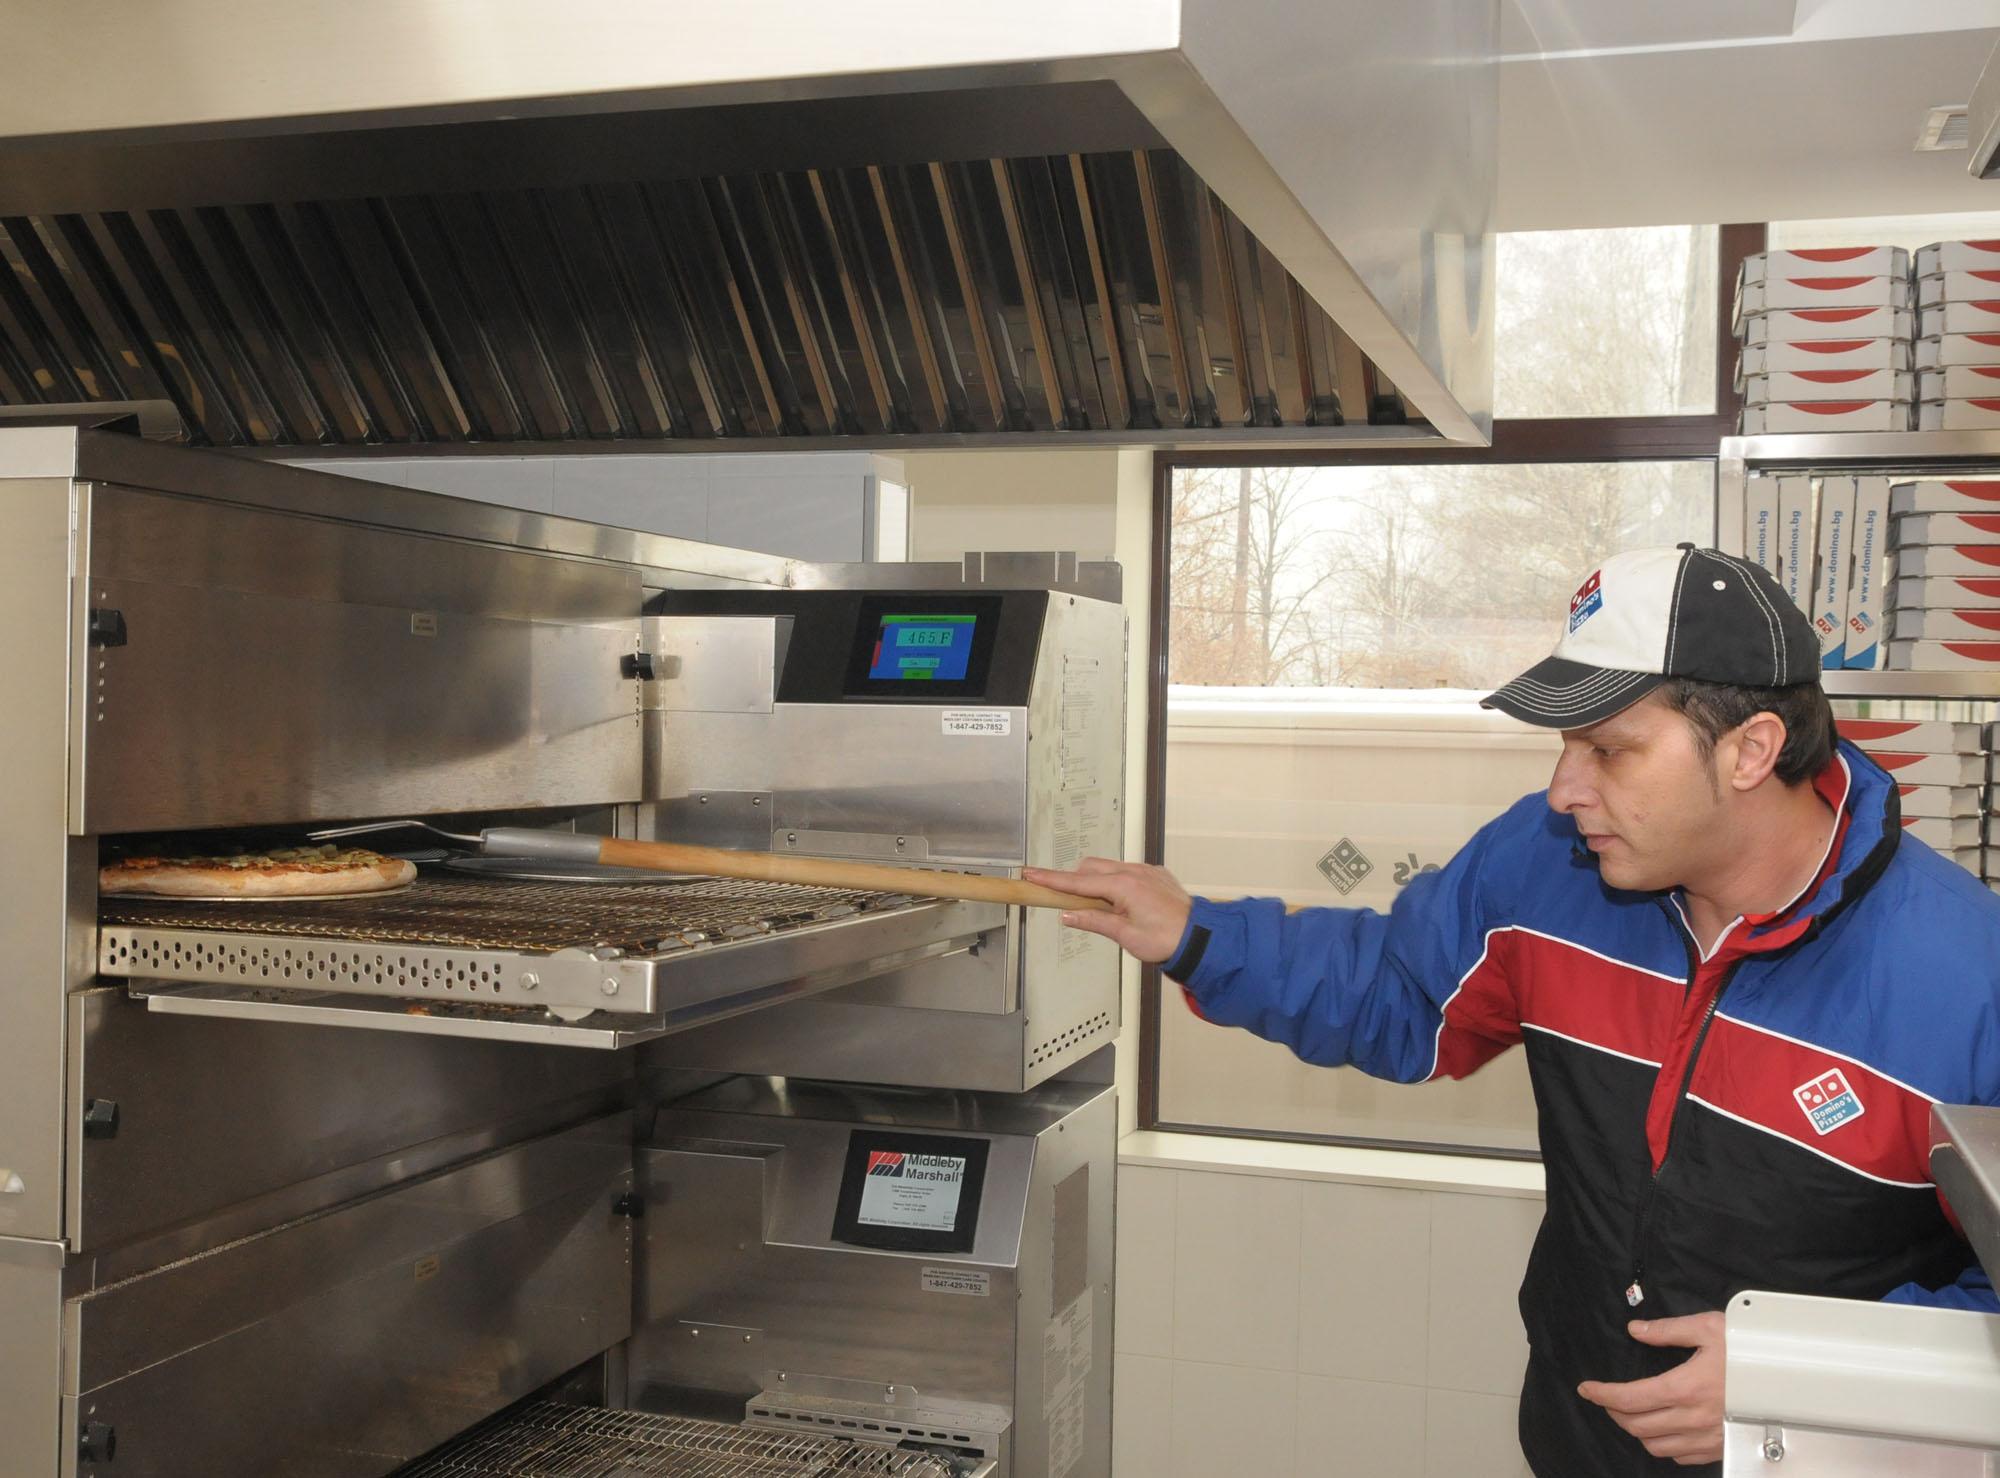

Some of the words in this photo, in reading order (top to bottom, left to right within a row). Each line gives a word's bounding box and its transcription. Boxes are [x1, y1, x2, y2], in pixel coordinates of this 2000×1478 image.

[1827, 510, 1843, 604] www.dominos.bg
[1860, 510, 1877, 603] www.dominos.bg
[949, 722, 1004, 731] 1-847-429-7852
[1813, 1096, 1852, 1120] Domino's
[907, 1154, 962, 1171] Middleby
